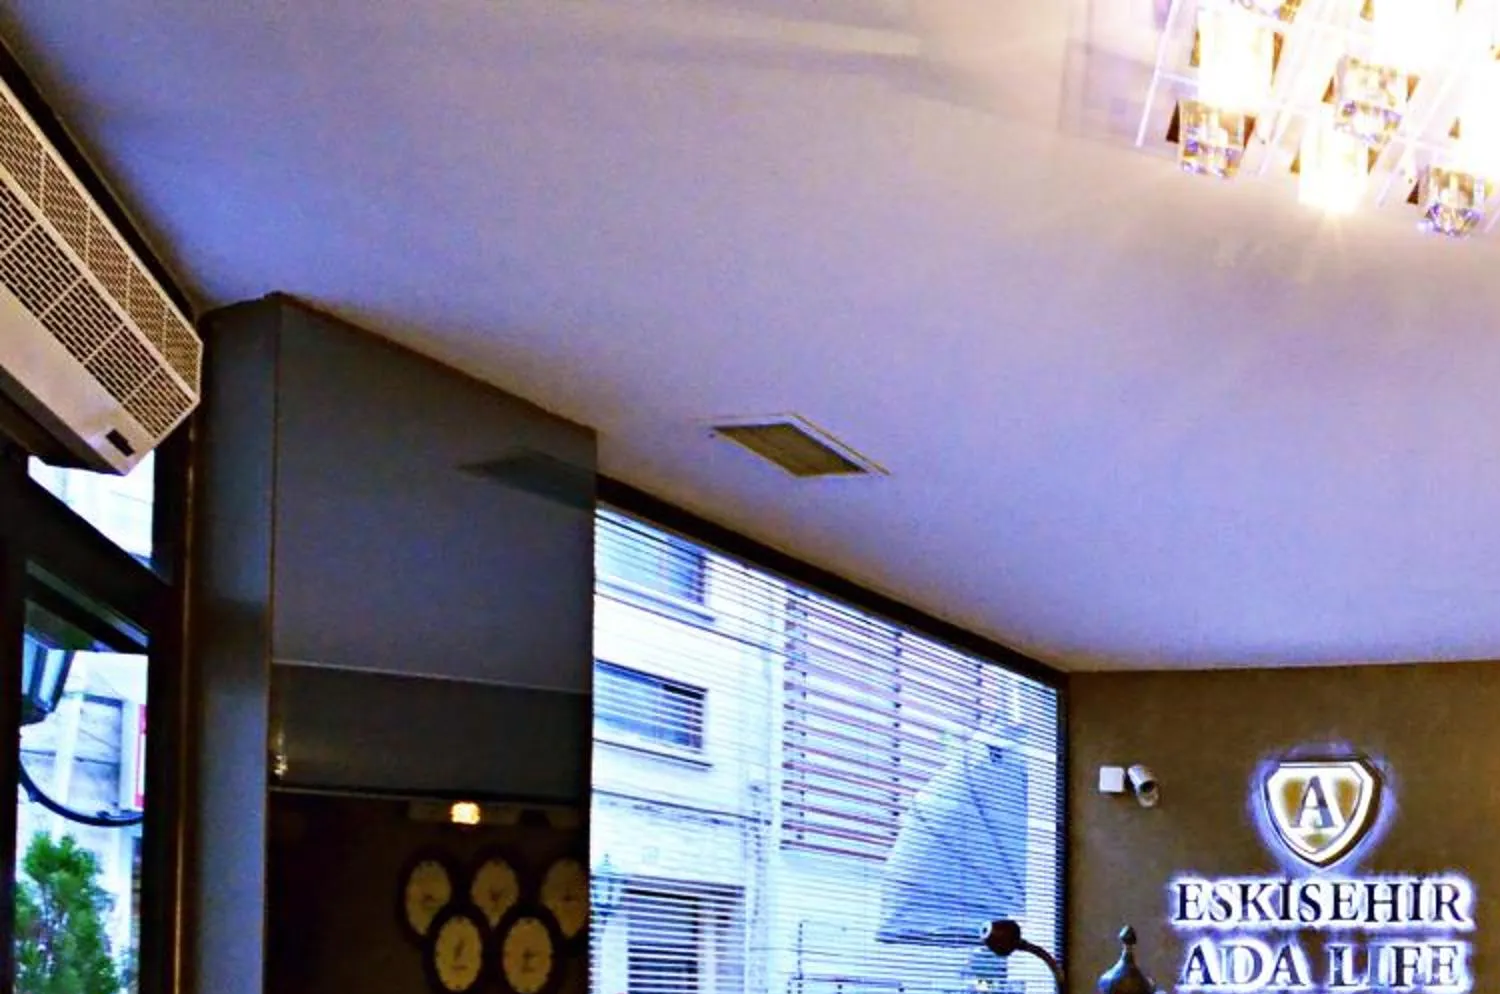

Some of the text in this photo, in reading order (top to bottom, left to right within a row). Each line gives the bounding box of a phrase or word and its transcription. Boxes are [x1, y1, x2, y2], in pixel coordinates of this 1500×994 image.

[1289, 775, 1339, 829] A
[1178, 943, 1461, 988] ADA LIFE
